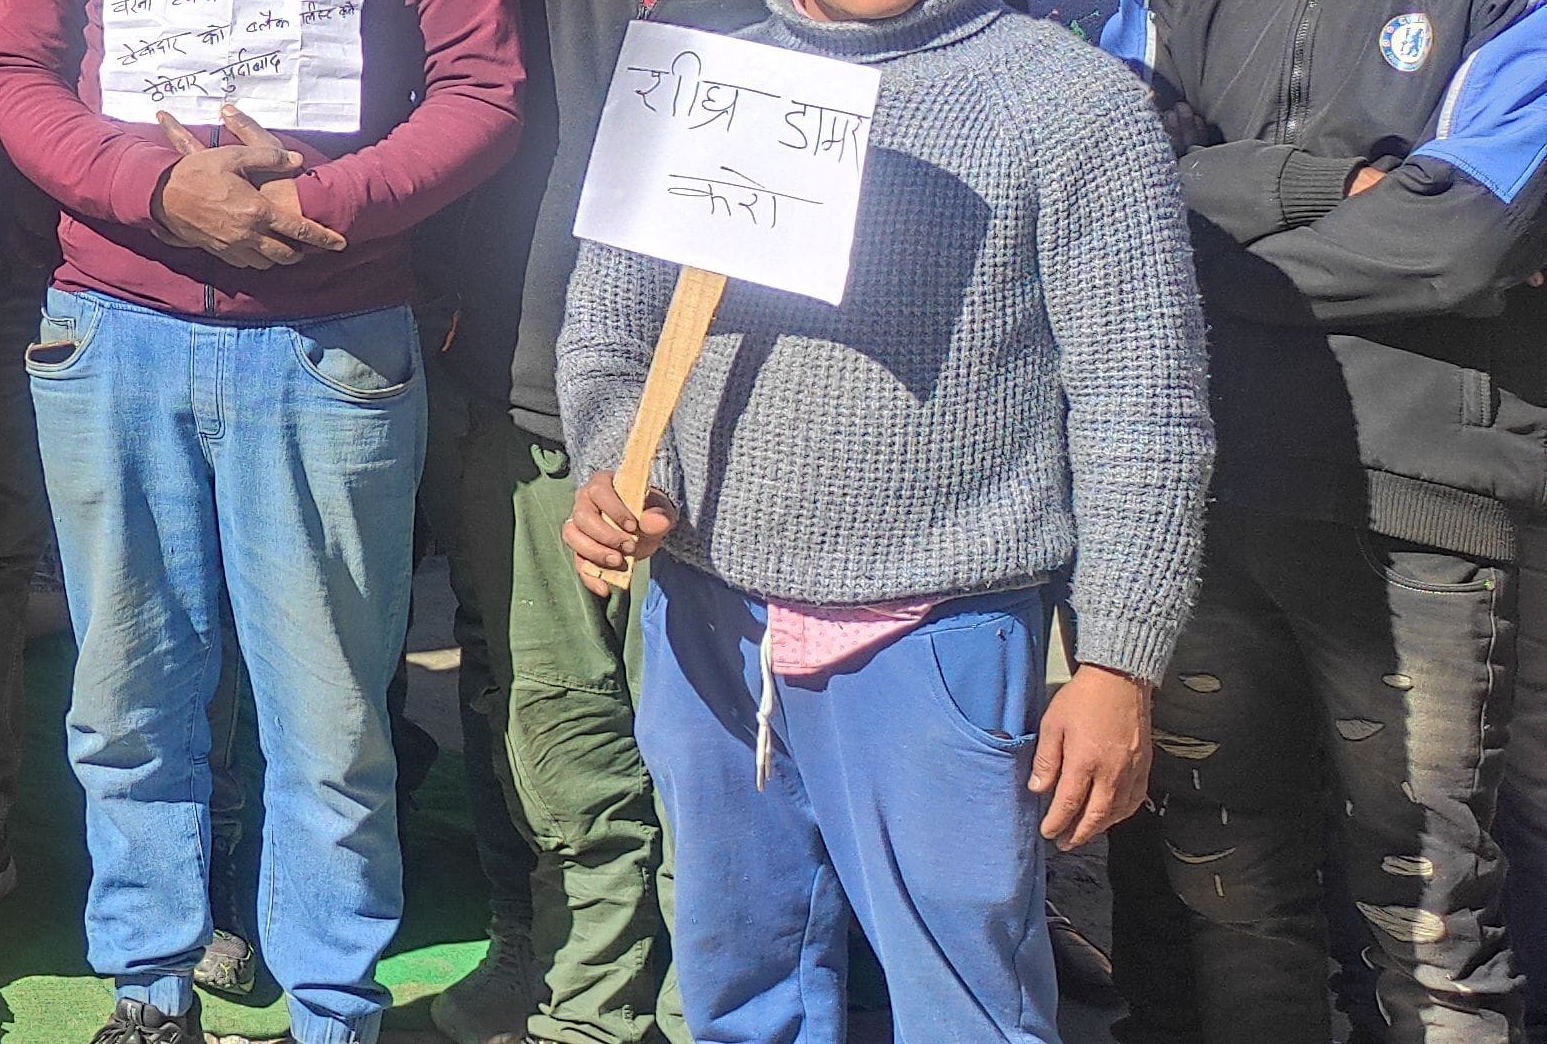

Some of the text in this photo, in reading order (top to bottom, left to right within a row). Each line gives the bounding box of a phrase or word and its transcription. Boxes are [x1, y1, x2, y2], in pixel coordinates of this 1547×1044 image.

[197, 24, 232, 47] को
[143, 68, 210, 103] ठेकेदार
[667, 165, 824, 229] करो
